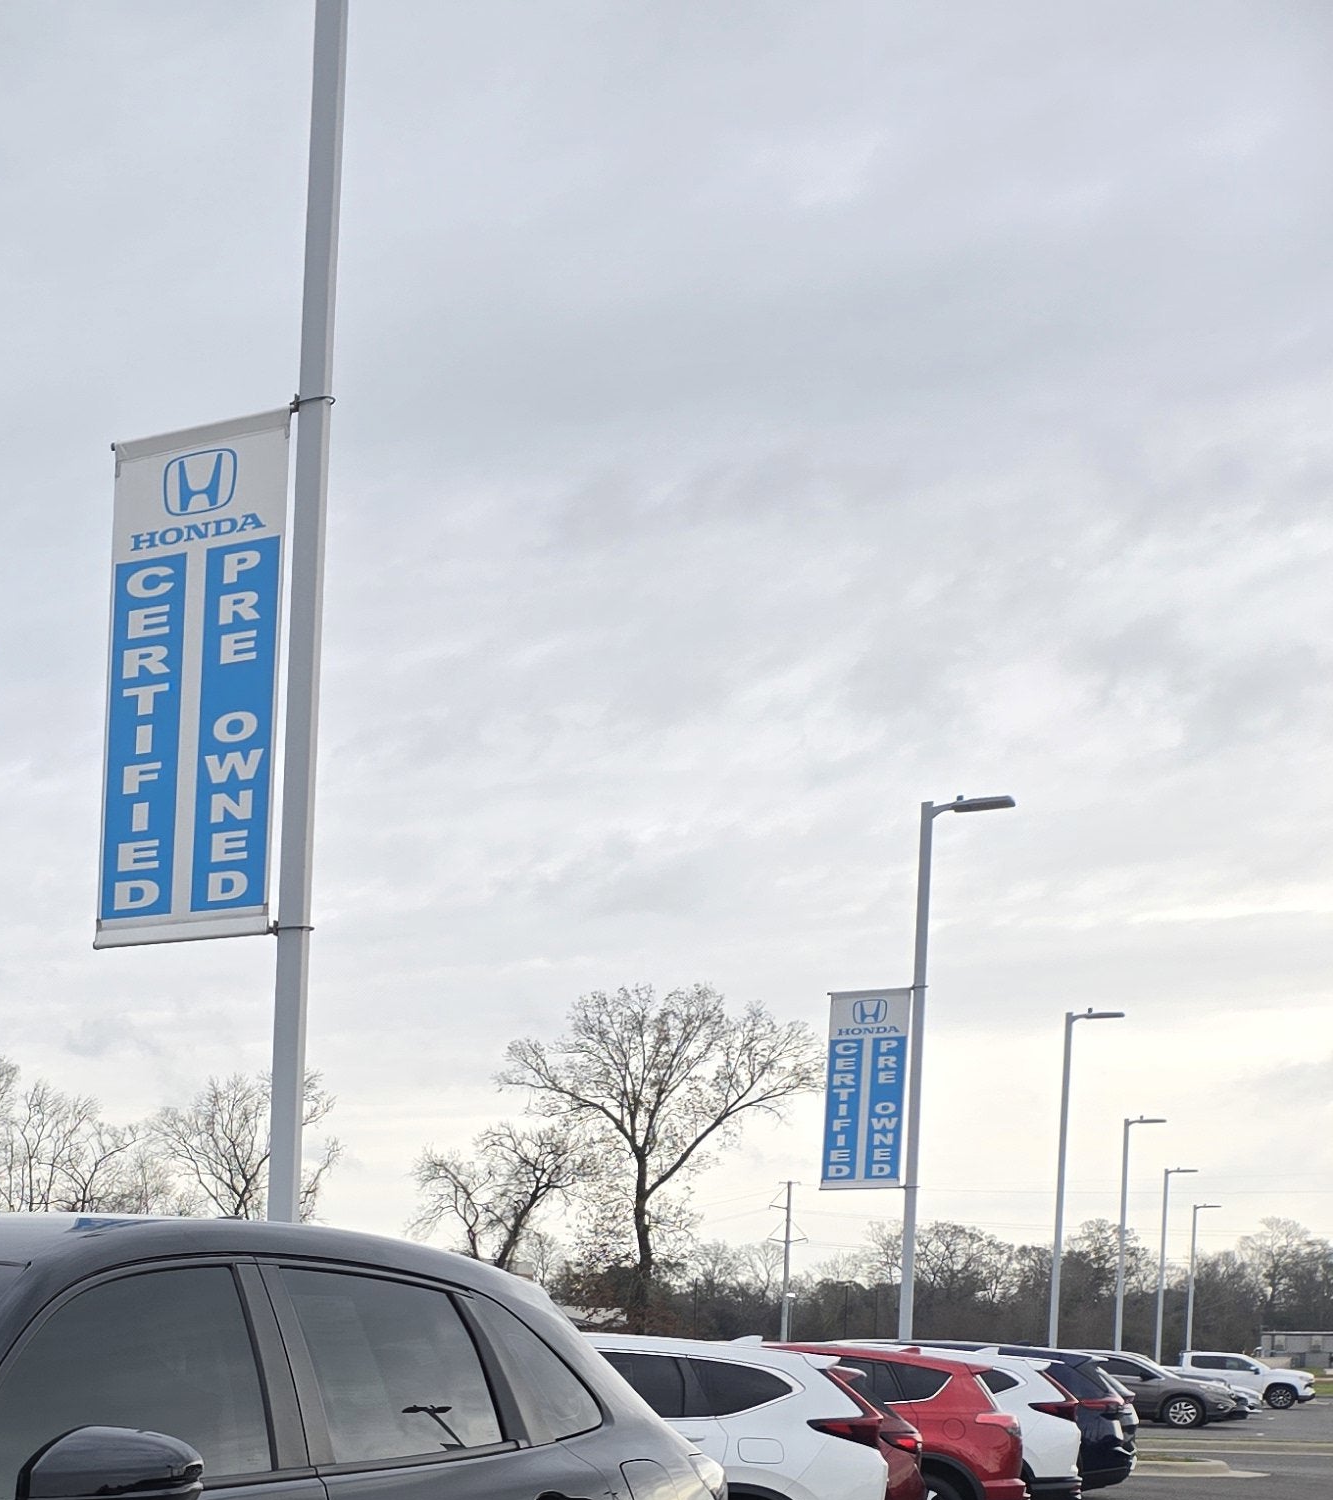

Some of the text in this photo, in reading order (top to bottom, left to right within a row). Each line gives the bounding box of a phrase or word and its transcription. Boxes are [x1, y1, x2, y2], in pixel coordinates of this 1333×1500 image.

[129, 512, 267, 552] HONDA
[113, 565, 175, 912] CERTIFIED
[204, 549, 264, 902] PRE OWNED
[836, 1025, 901, 1036] HONDA
[827, 1042, 859, 1178] CERTIFIED
[870, 1039, 899, 1177] PRE OWNED
